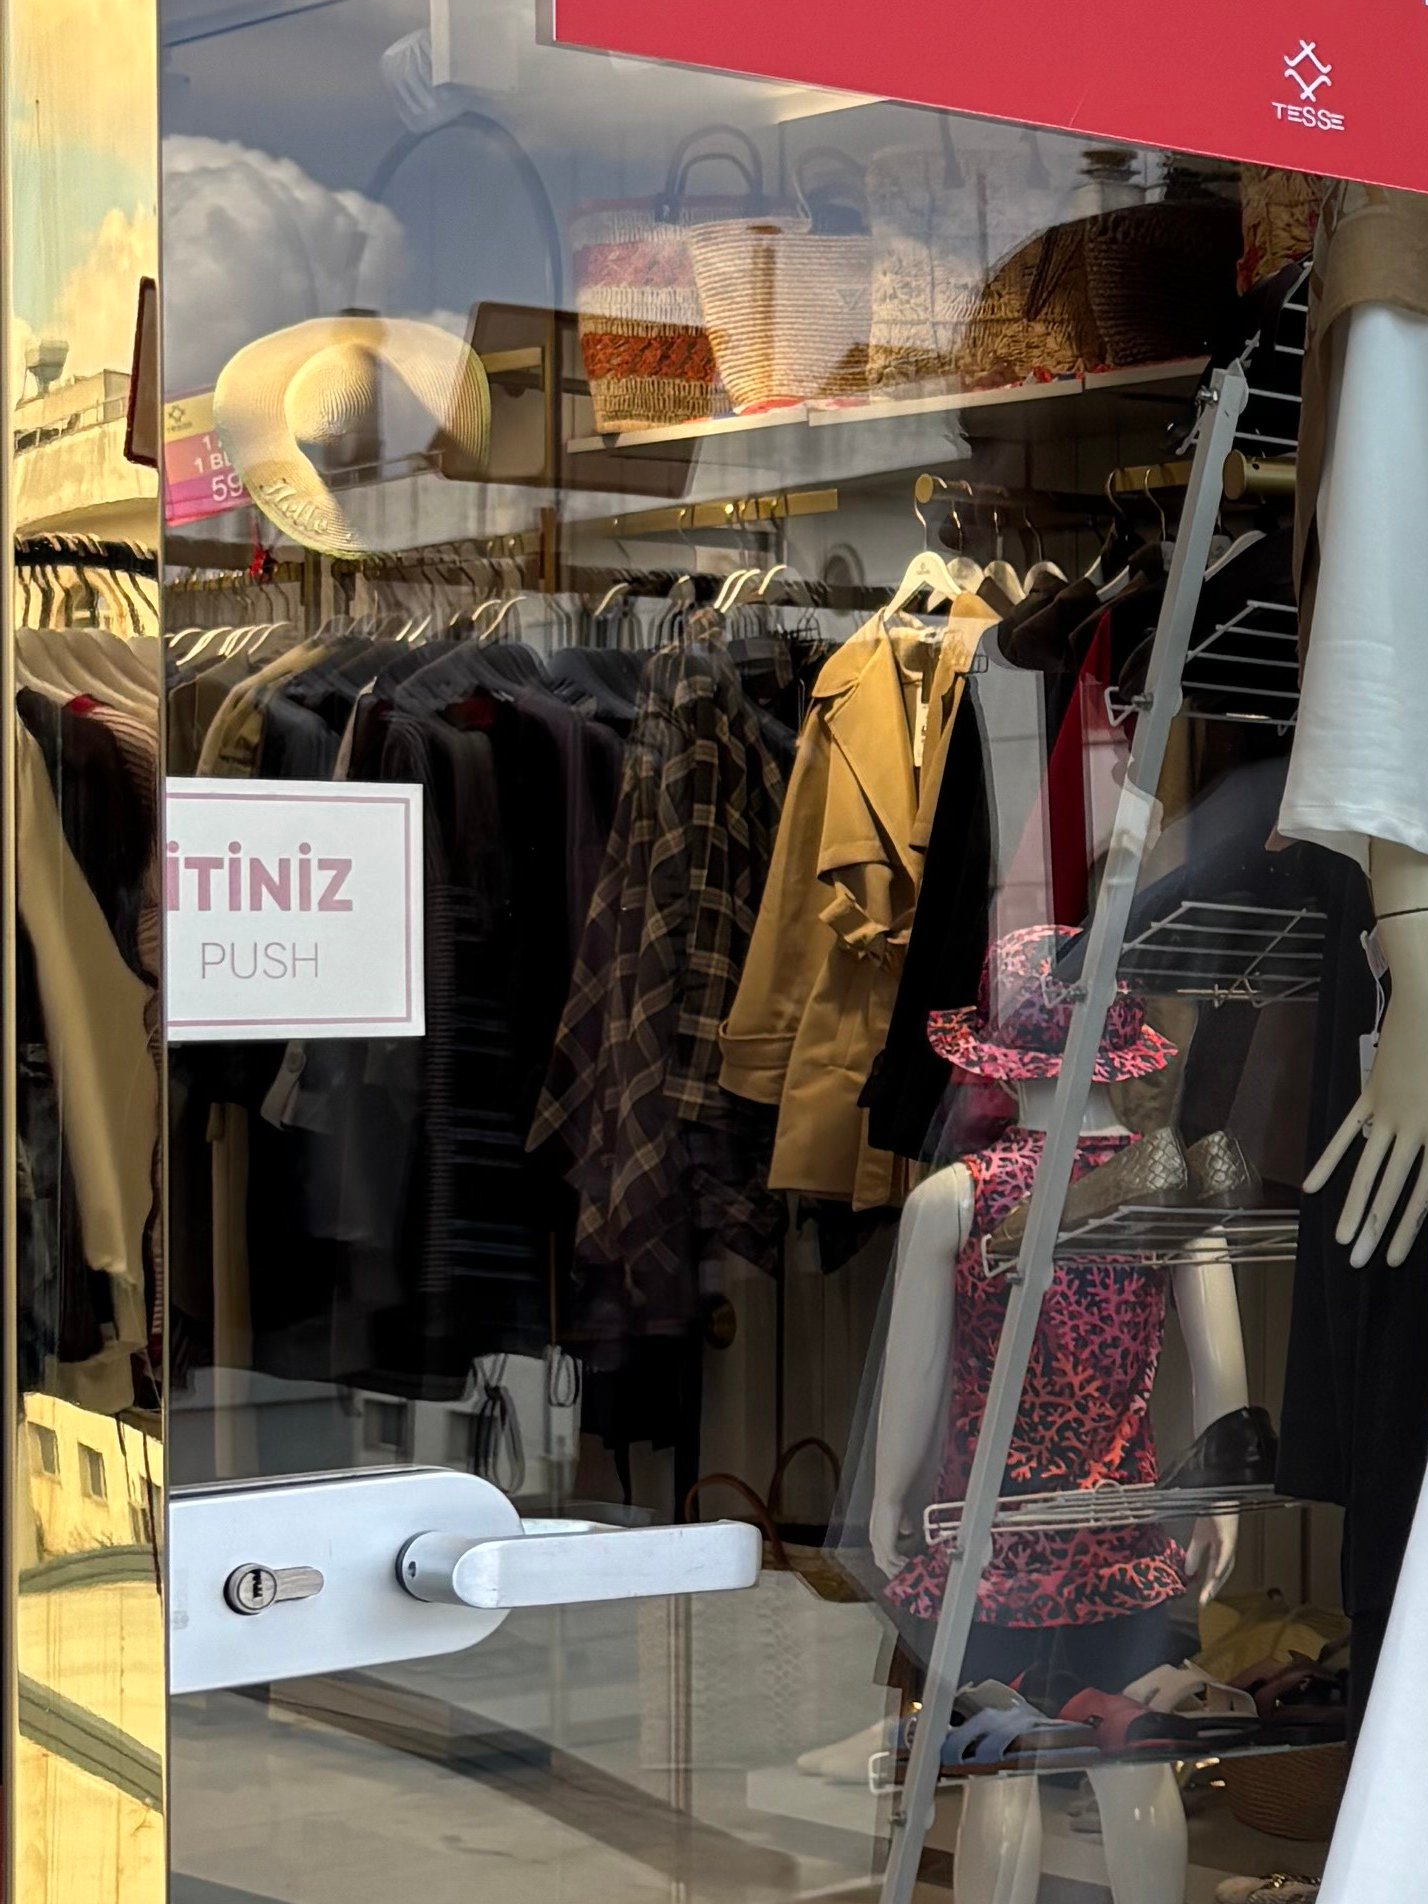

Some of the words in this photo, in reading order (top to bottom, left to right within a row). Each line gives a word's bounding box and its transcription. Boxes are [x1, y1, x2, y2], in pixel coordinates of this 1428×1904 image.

[1272, 102, 1345, 132] TESSE
[167, 840, 354, 912] İTİNİZ
[200, 941, 319, 980] PUSH
